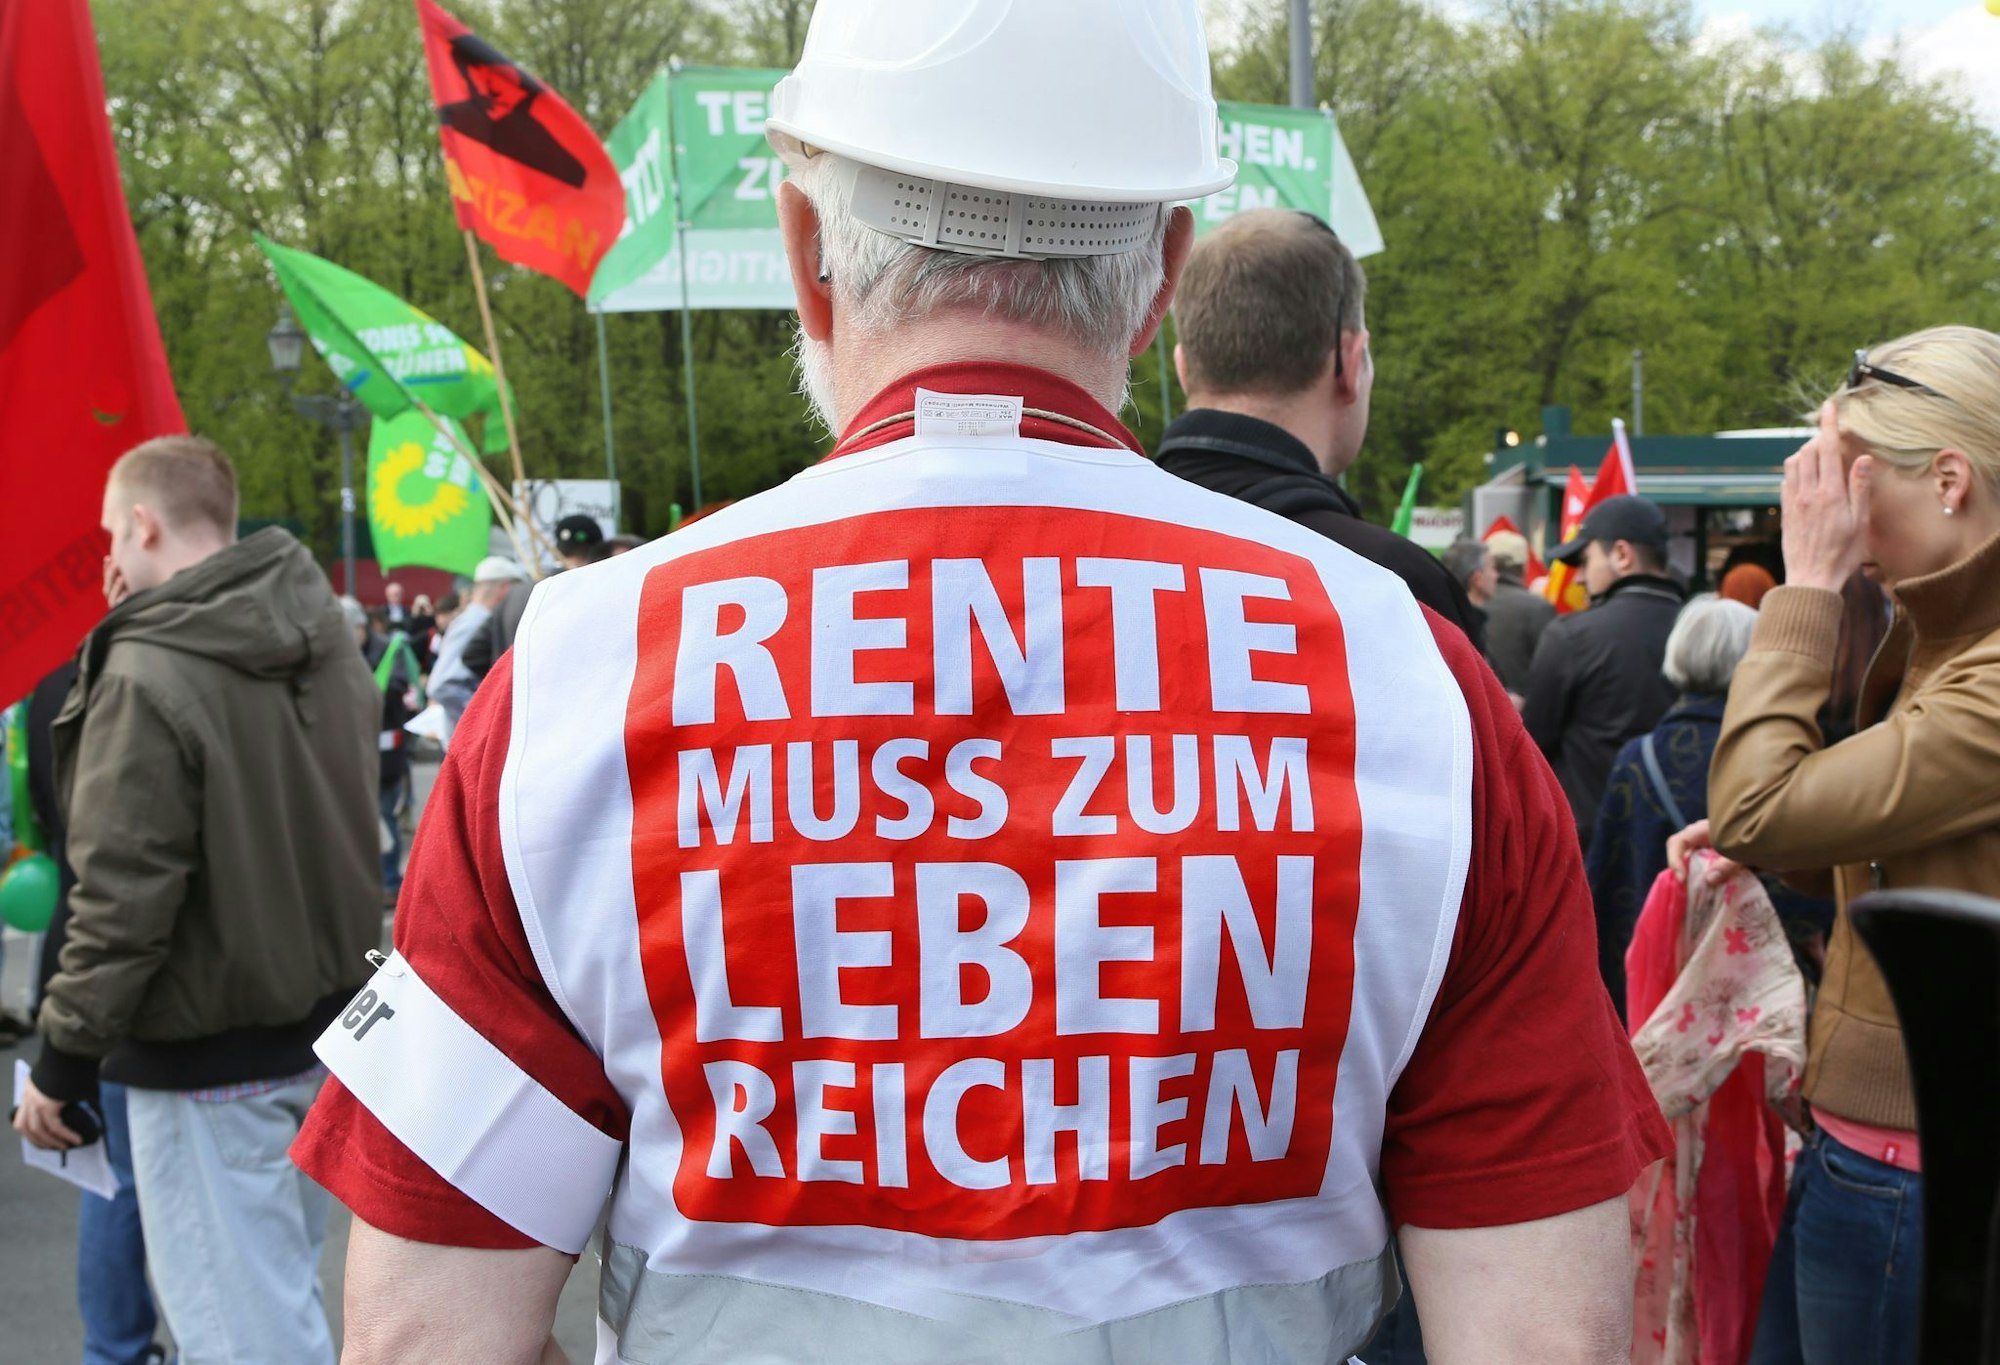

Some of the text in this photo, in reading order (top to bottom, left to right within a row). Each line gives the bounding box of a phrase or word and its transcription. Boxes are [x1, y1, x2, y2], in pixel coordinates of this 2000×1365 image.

[696, 91, 774, 135] TE
[672, 557, 1311, 726] RENTE
[677, 734, 1314, 848] MUSS ZUM
[680, 855, 1314, 1042] LEBEN
[338, 983, 396, 1042] er
[703, 1049, 1299, 1189] REICHEN
